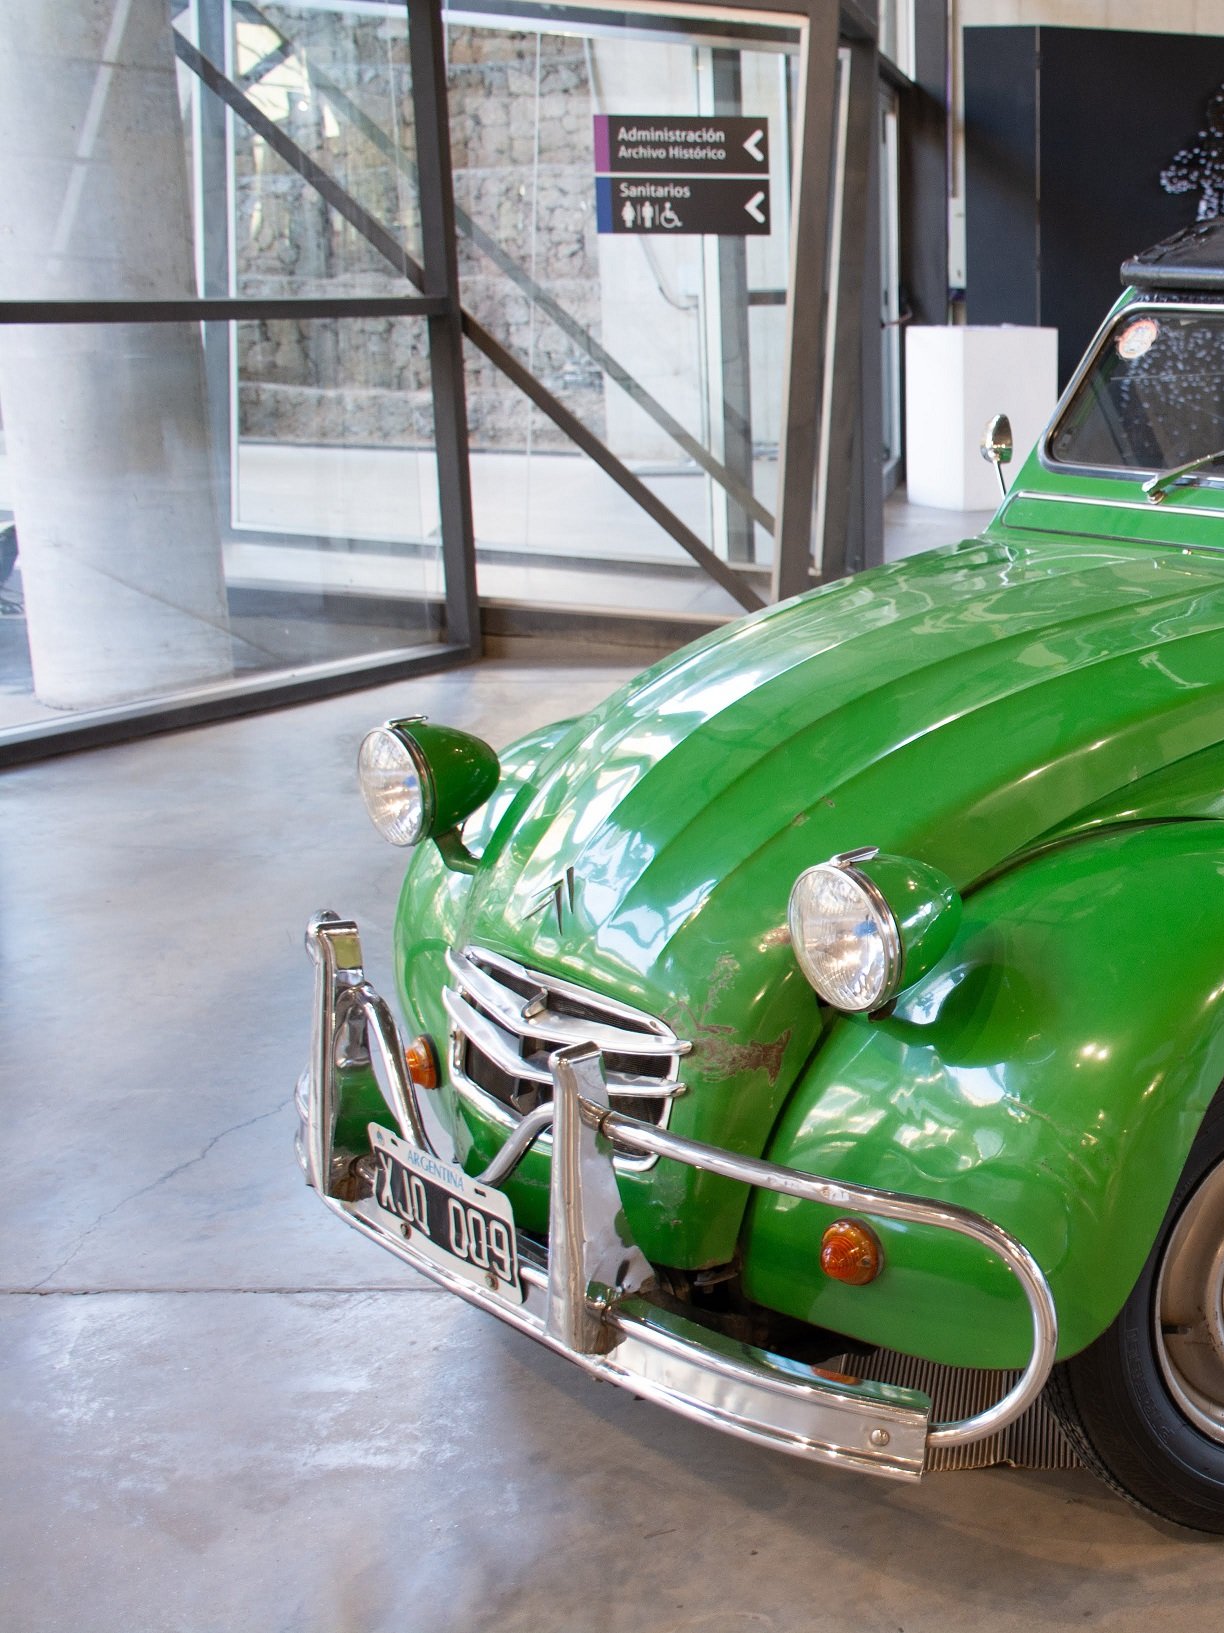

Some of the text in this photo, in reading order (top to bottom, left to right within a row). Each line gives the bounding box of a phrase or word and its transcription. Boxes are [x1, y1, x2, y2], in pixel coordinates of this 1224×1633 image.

[617, 126, 726, 143] Administración
[618, 146, 727, 160] Archivo Histórico
[619, 182, 691, 198] Sanitarios
[407, 1150, 465, 1192] ARGENTINA
[378, 1151, 512, 1282] XJQ 009
